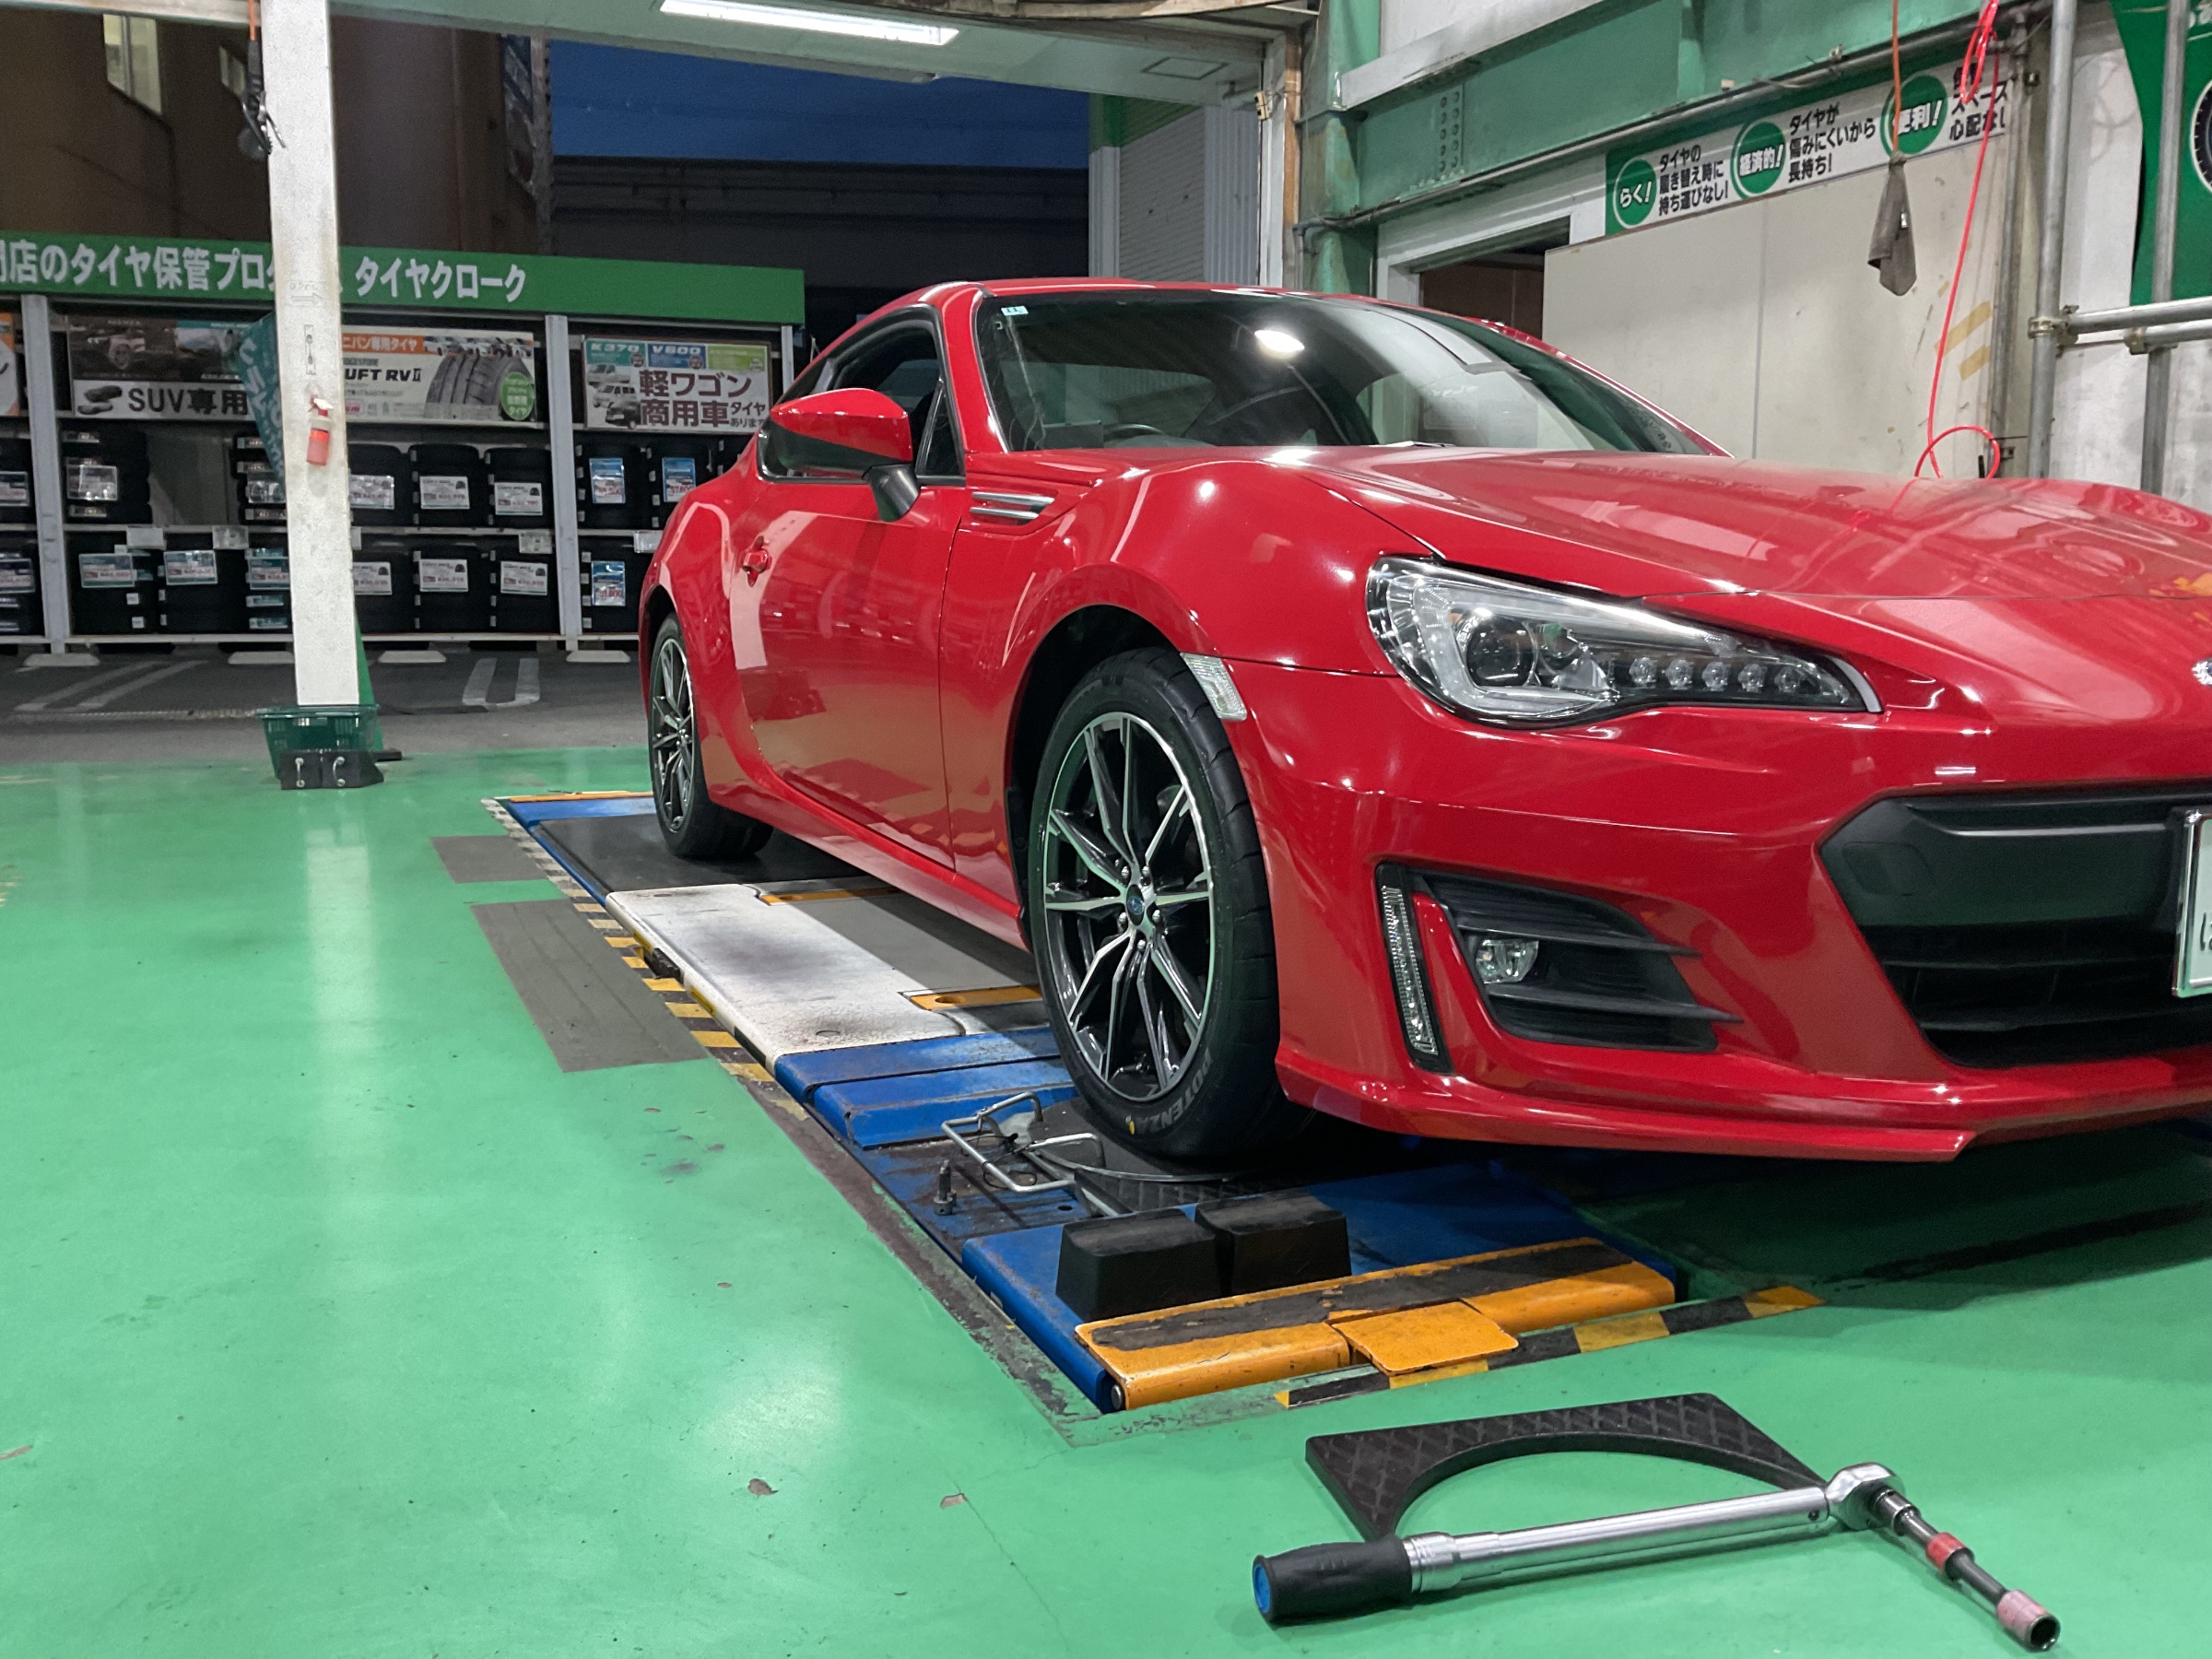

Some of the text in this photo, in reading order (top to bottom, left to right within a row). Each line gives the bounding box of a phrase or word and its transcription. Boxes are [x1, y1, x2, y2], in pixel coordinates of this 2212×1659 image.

[1789, 102, 1841, 135] タイヤが
[1659, 144, 1701, 172] タイヤの
[1620, 181, 1653, 208] らく!
[0, 238, 526, 303] 店のタイヤ保管プロ タイヤクローク
[640, 371, 752, 398] 軽ワゴン
[127, 387, 248, 416] SUV専用
[641, 398, 766, 428] 商用車 タイヤ
